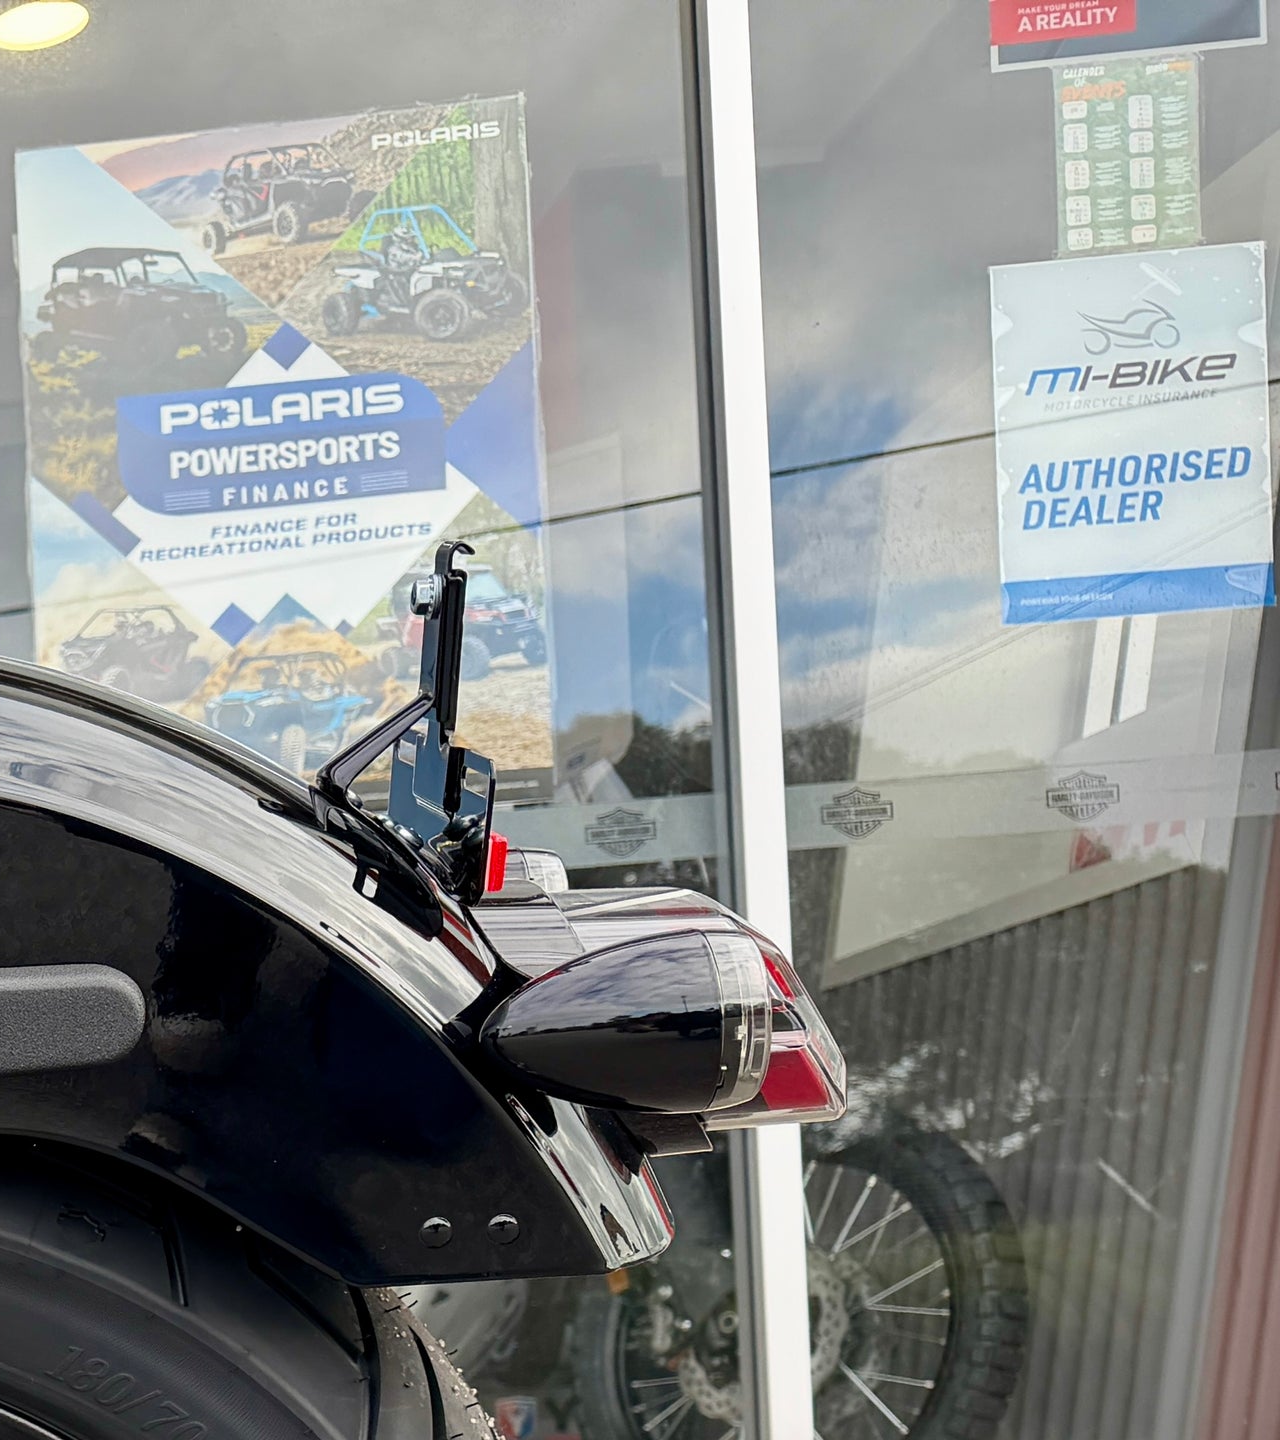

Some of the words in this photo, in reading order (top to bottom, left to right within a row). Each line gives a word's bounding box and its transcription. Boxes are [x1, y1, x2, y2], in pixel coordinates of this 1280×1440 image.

[1018, 6, 1041, 14] MAKE
[1044, 3, 1066, 11] YOUR
[1018, 16, 1032, 32] A
[1036, 6, 1118, 31] REALITY
[371, 120, 500, 150] POLARIS
[160, 383, 405, 435] POLARIS
[1044, 395, 1135, 412] MOTORCYCLE
[1139, 388, 1219, 405] INSURANCE
[170, 430, 401, 480] POWERSPORTS
[1018, 446, 1252, 495] AUTHORISED
[222, 475, 349, 507] FINANCE
[211, 518, 307, 540] FINANCE
[314, 512, 358, 530] FOR
[1022, 490, 1164, 531] DEALER
[139, 537, 305, 562] RECREATIONAL
[312, 522, 433, 547] PRODUCTS
